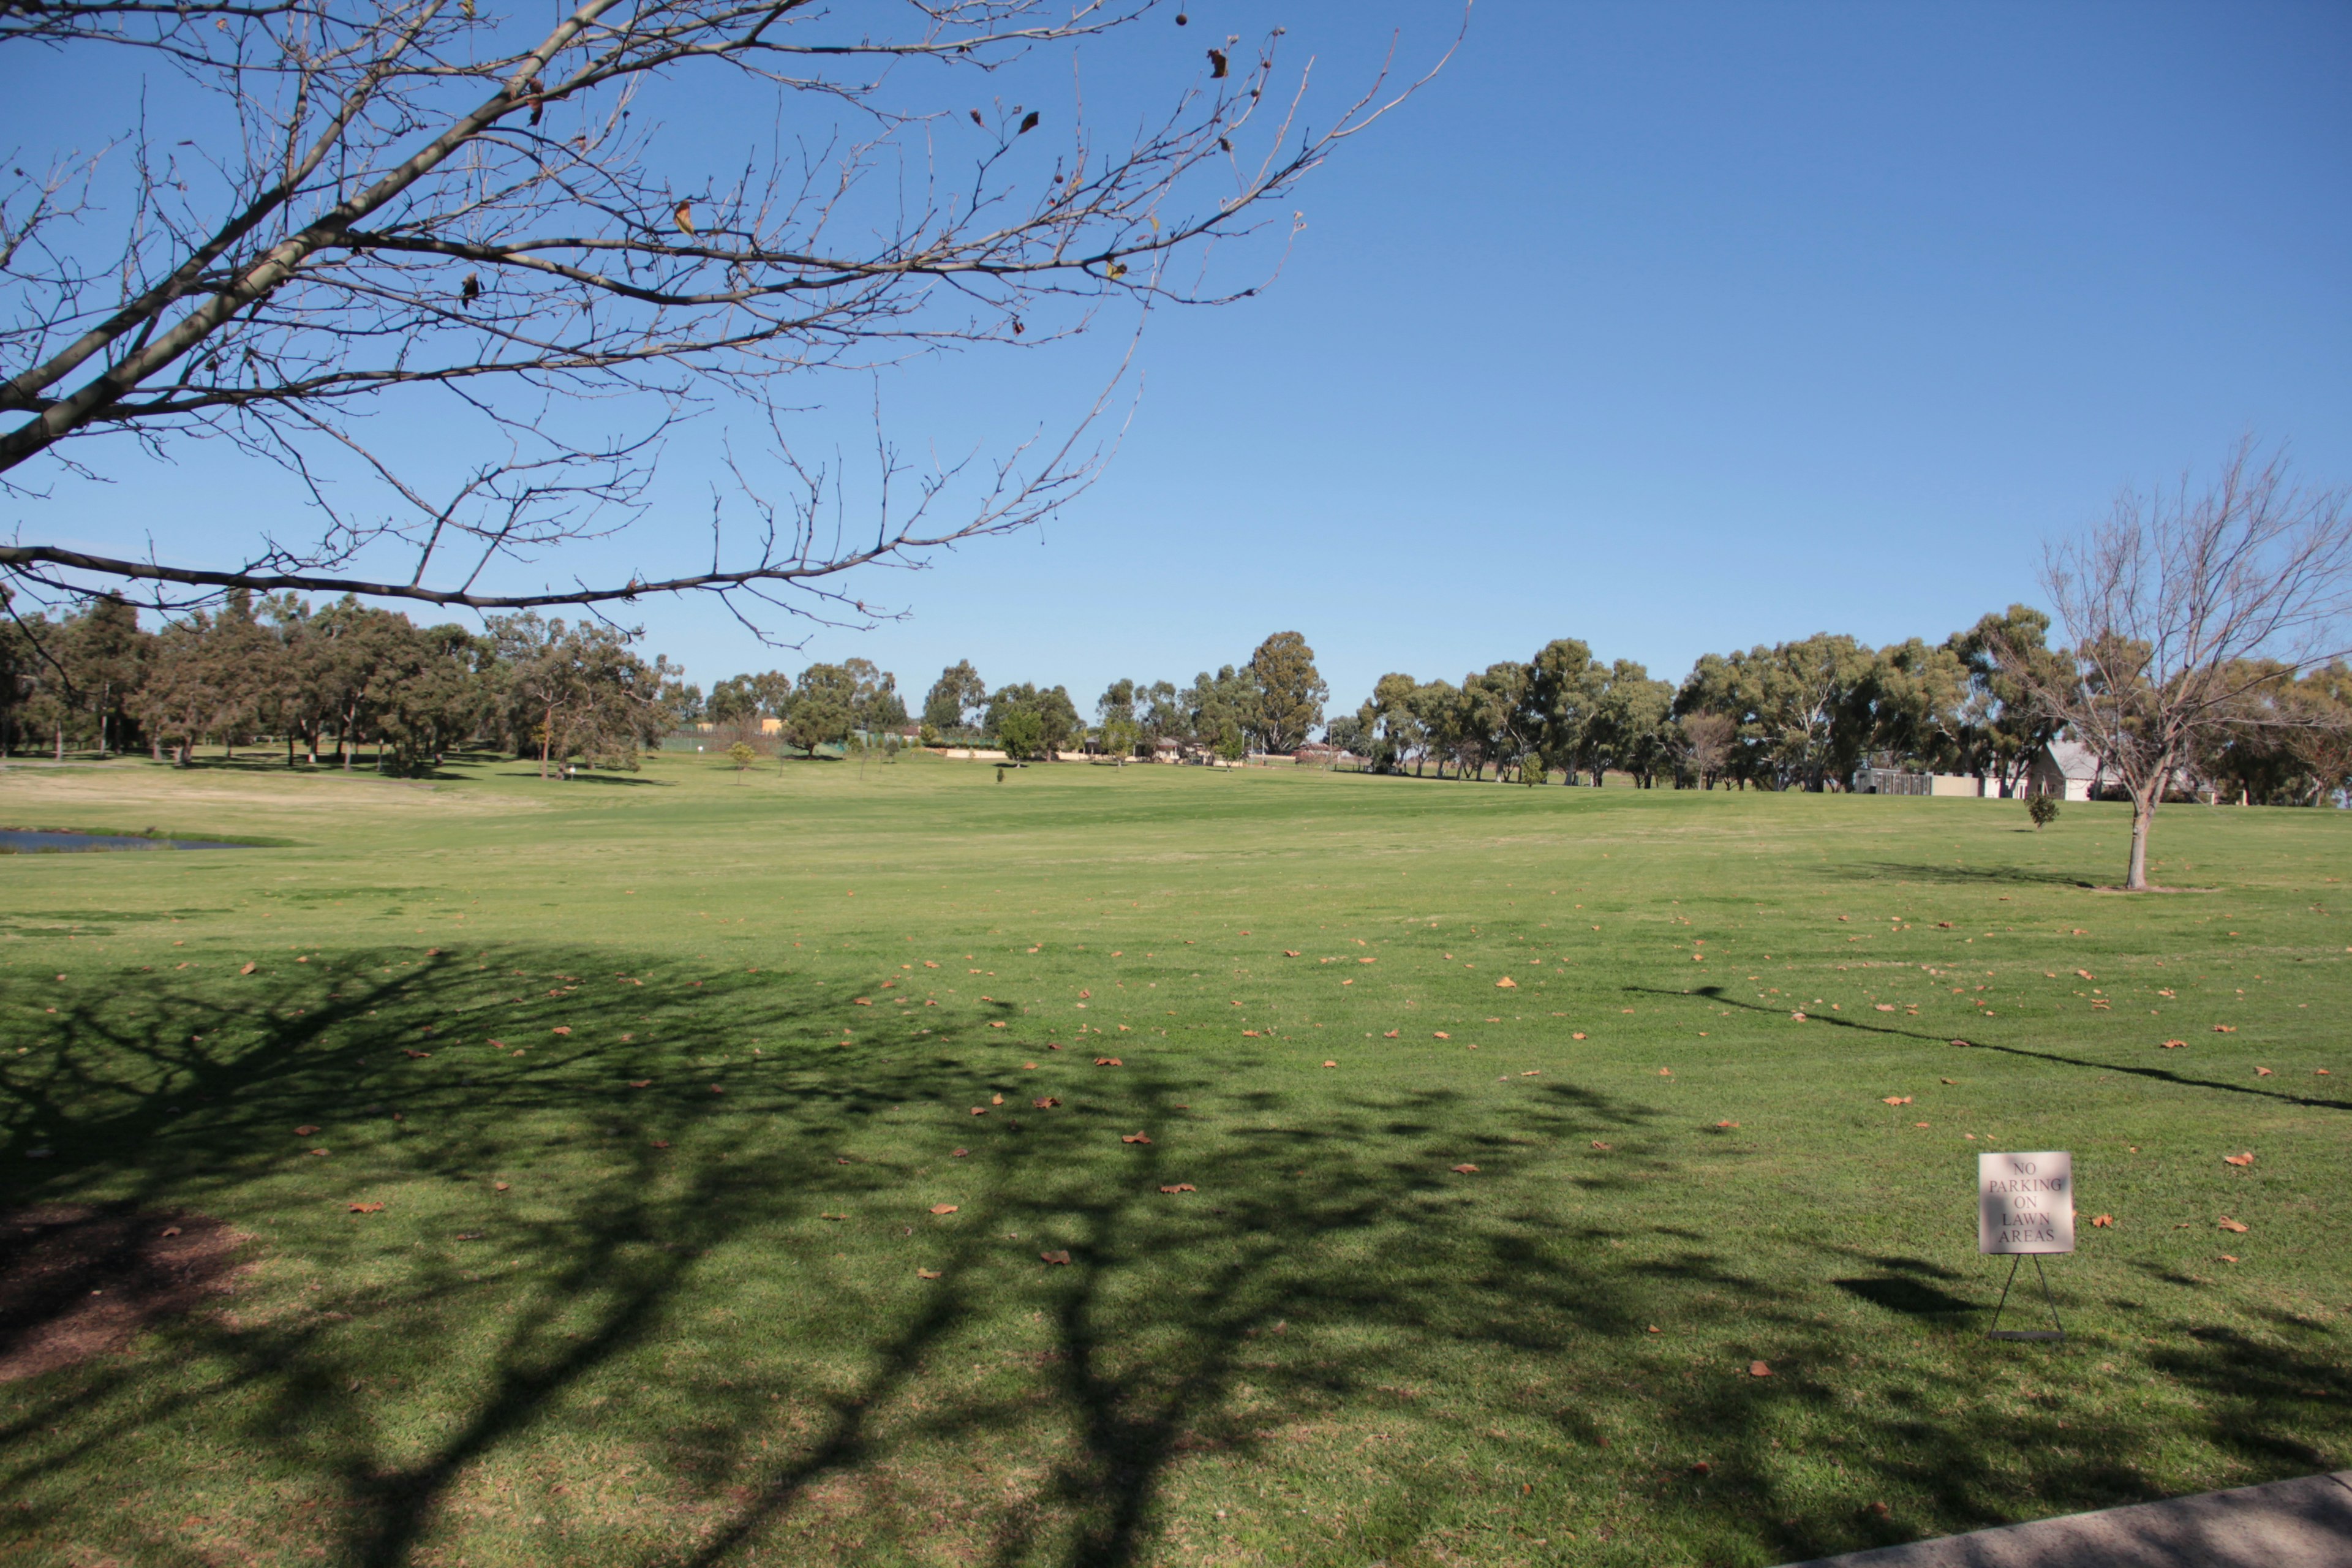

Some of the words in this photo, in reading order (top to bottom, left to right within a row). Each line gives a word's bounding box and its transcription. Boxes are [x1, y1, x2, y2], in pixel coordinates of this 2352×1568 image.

[2014, 1162, 2037, 1175] NO
[1989, 1178, 2062, 1193] PARKING
[2014, 1196, 2037, 1209] ON
[2002, 1212, 2050, 1226] LAWN
[1999, 1229, 2054, 1243] AREAS
